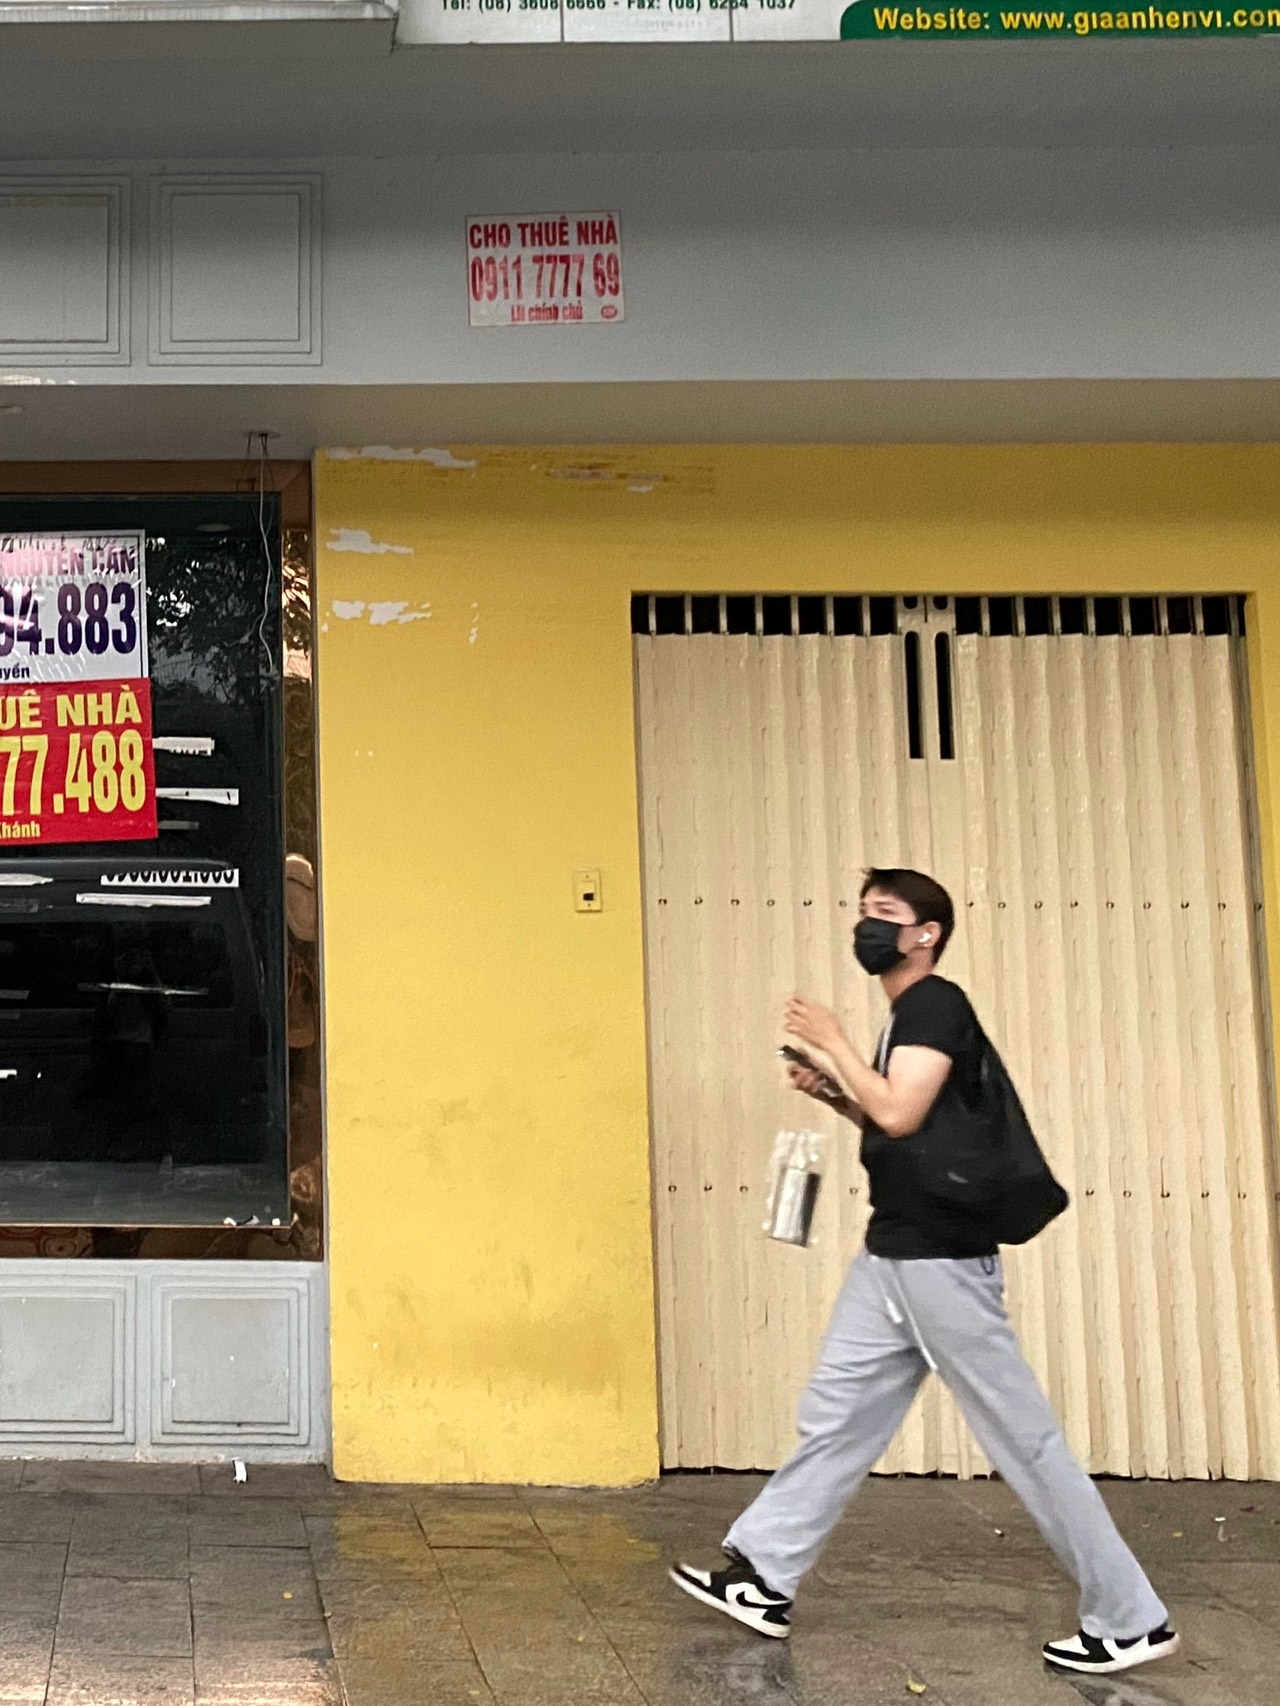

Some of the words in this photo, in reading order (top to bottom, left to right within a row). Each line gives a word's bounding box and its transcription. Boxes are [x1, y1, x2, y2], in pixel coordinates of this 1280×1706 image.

[873, 6, 990, 30] Website:
[470, 223, 511, 249] CHO
[517, 215, 569, 247] THUÊ
[576, 214, 618, 246] NHÀ
[471, 255, 523, 302] 0911
[532, 253, 585, 298] 7777
[593, 252, 620, 298] 69
[56, 685, 142, 727] NHÀ
